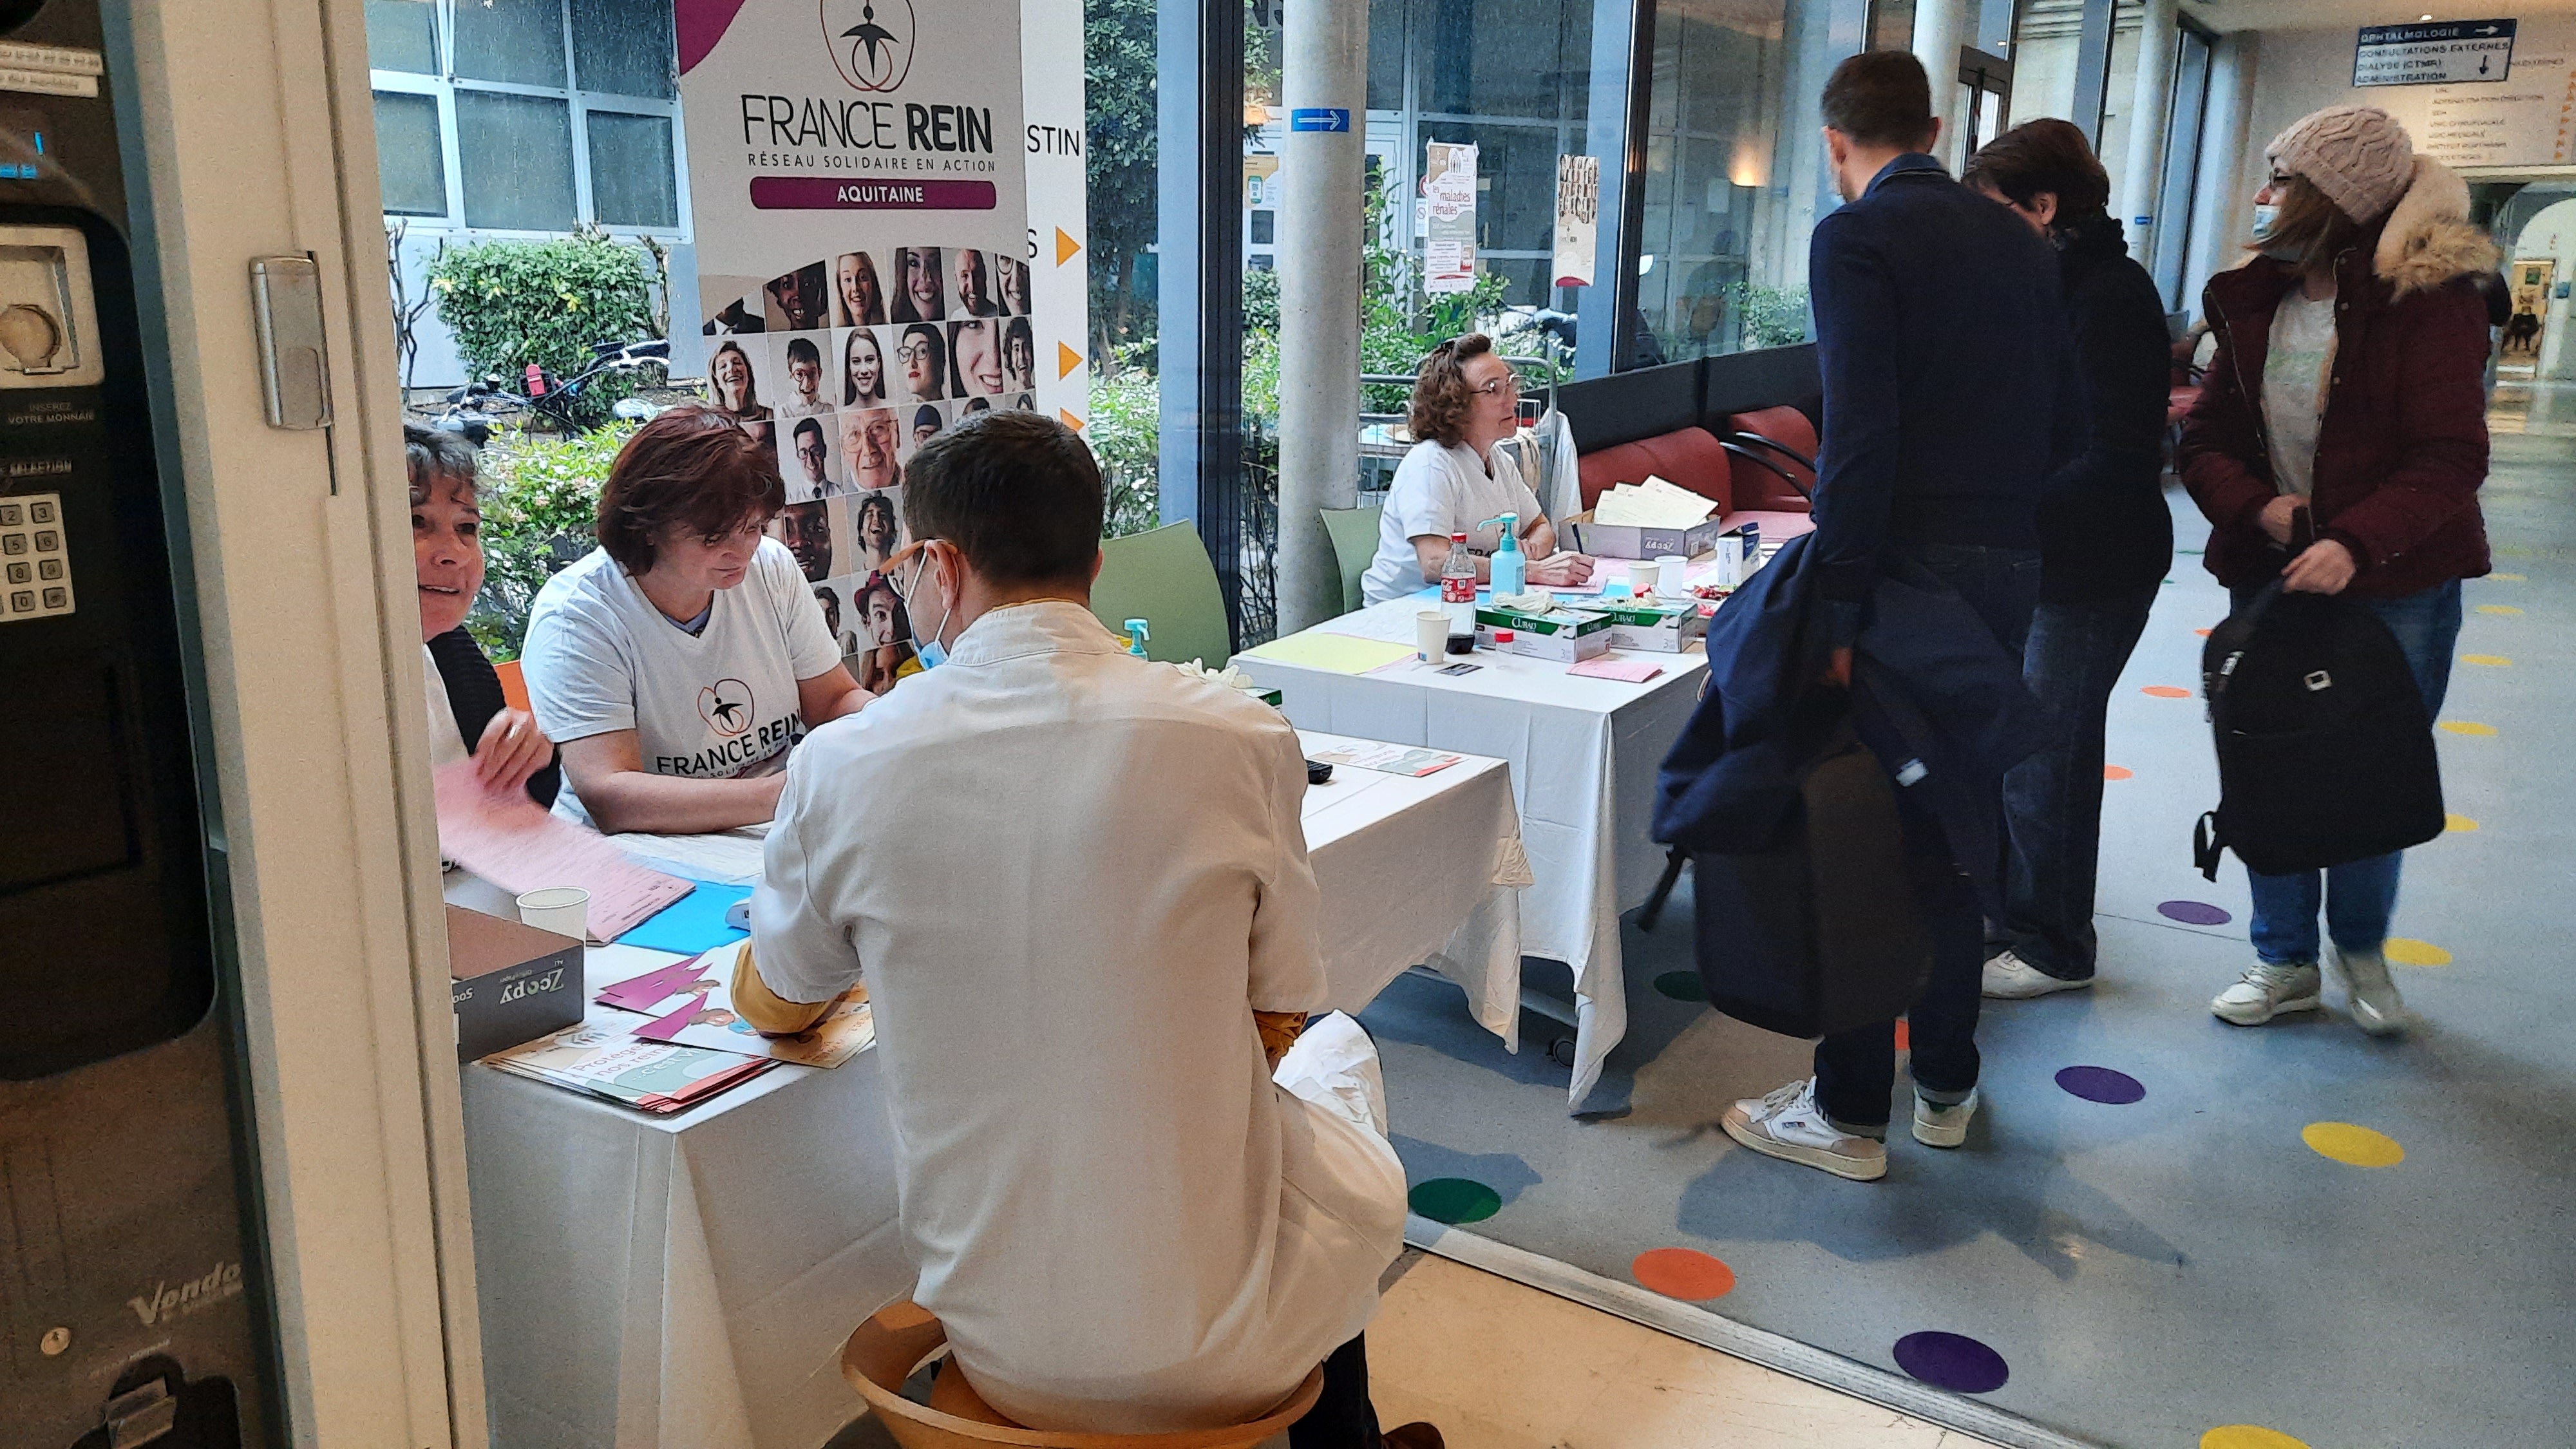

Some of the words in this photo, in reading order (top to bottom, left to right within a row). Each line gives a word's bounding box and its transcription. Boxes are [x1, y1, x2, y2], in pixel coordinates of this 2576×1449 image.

[741, 94, 897, 150] FRANCE
[904, 102, 994, 154] REIN
[1026, 124, 1081, 156] STIN
[748, 151, 815, 167] RÉSEAU
[824, 155, 909, 170] SOLIDAIRE
[916, 158, 935, 171] EN
[943, 159, 996, 172] ACTION
[837, 185, 925, 204] AQUITAINE
[656, 734, 756, 775] FRANCE
[758, 708, 800, 750] REIN
[499, 967, 565, 1005] Zcopy
[594, 1063, 630, 1077] nos
[627, 1045, 676, 1065] reins
[126, 1260, 242, 1327] Vendo
